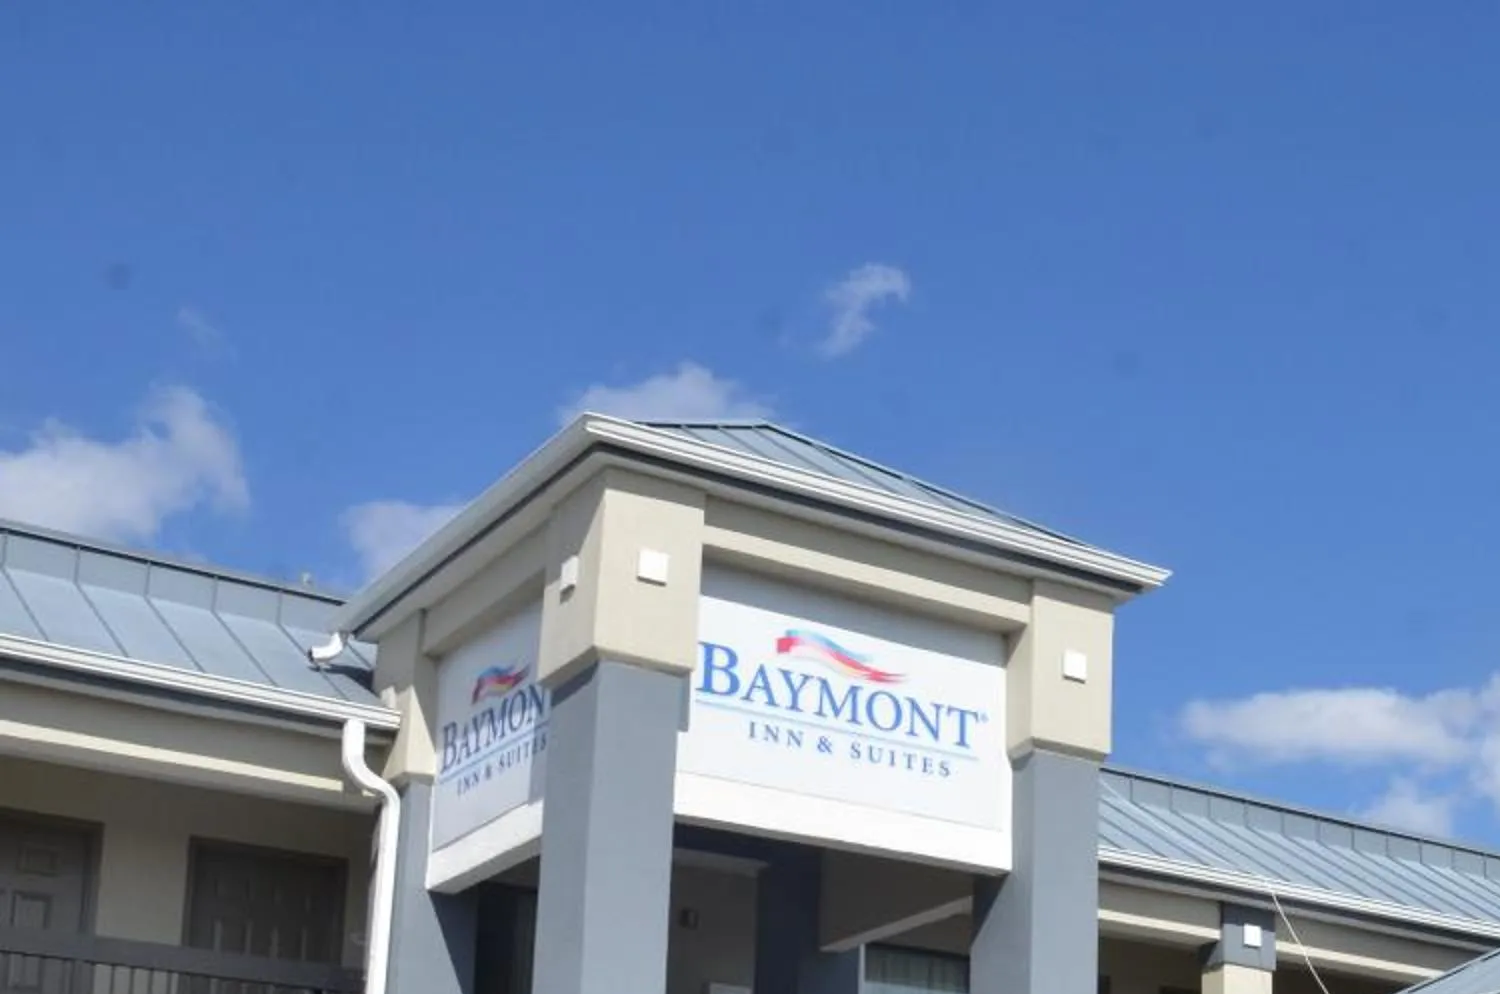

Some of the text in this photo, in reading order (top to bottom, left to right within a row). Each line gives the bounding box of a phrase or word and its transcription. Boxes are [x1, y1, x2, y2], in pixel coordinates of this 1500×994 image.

[440, 684, 546, 774] BAYMON
[695, 640, 979, 748] BAYMONT
[457, 773, 479, 796] INN
[748, 721, 952, 778] INN & SUITES
